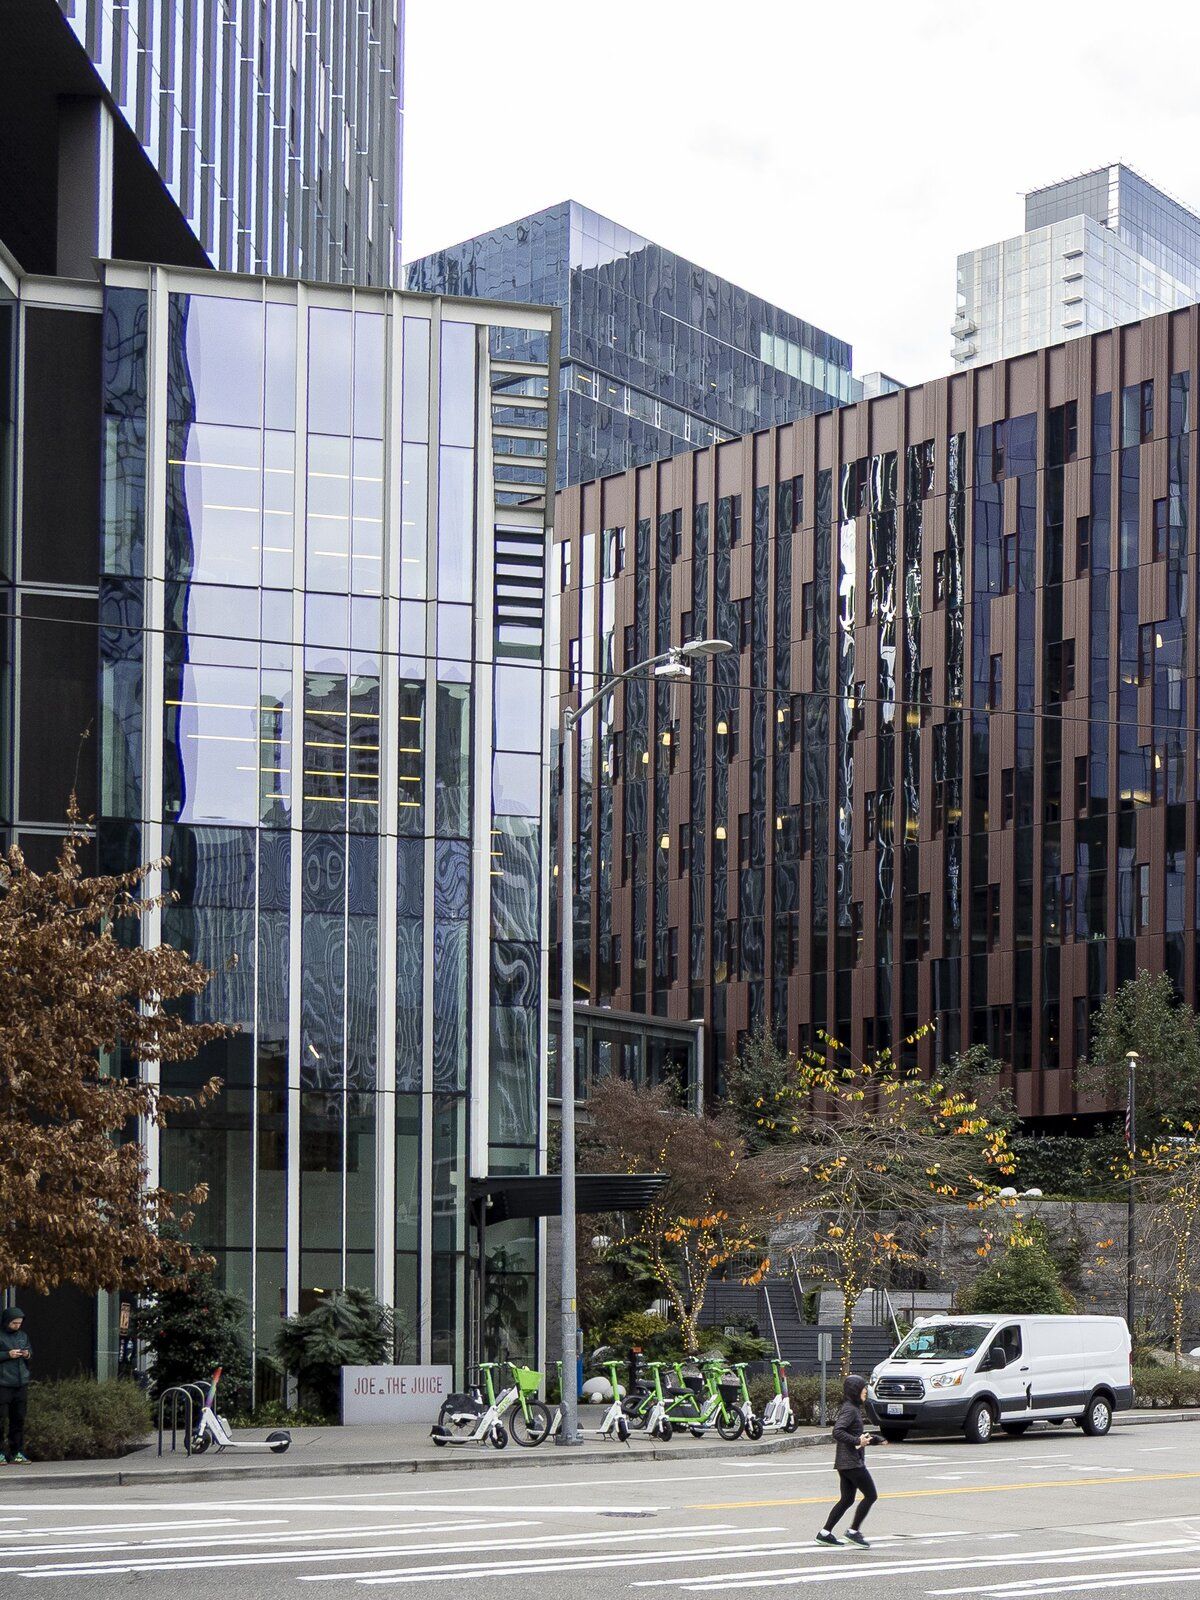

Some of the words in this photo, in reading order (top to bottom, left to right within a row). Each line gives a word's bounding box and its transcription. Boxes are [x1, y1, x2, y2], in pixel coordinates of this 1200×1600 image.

[354, 1377, 376, 1395] JOE
[386, 1377, 407, 1395] THE
[411, 1376, 443, 1394] JUICE
